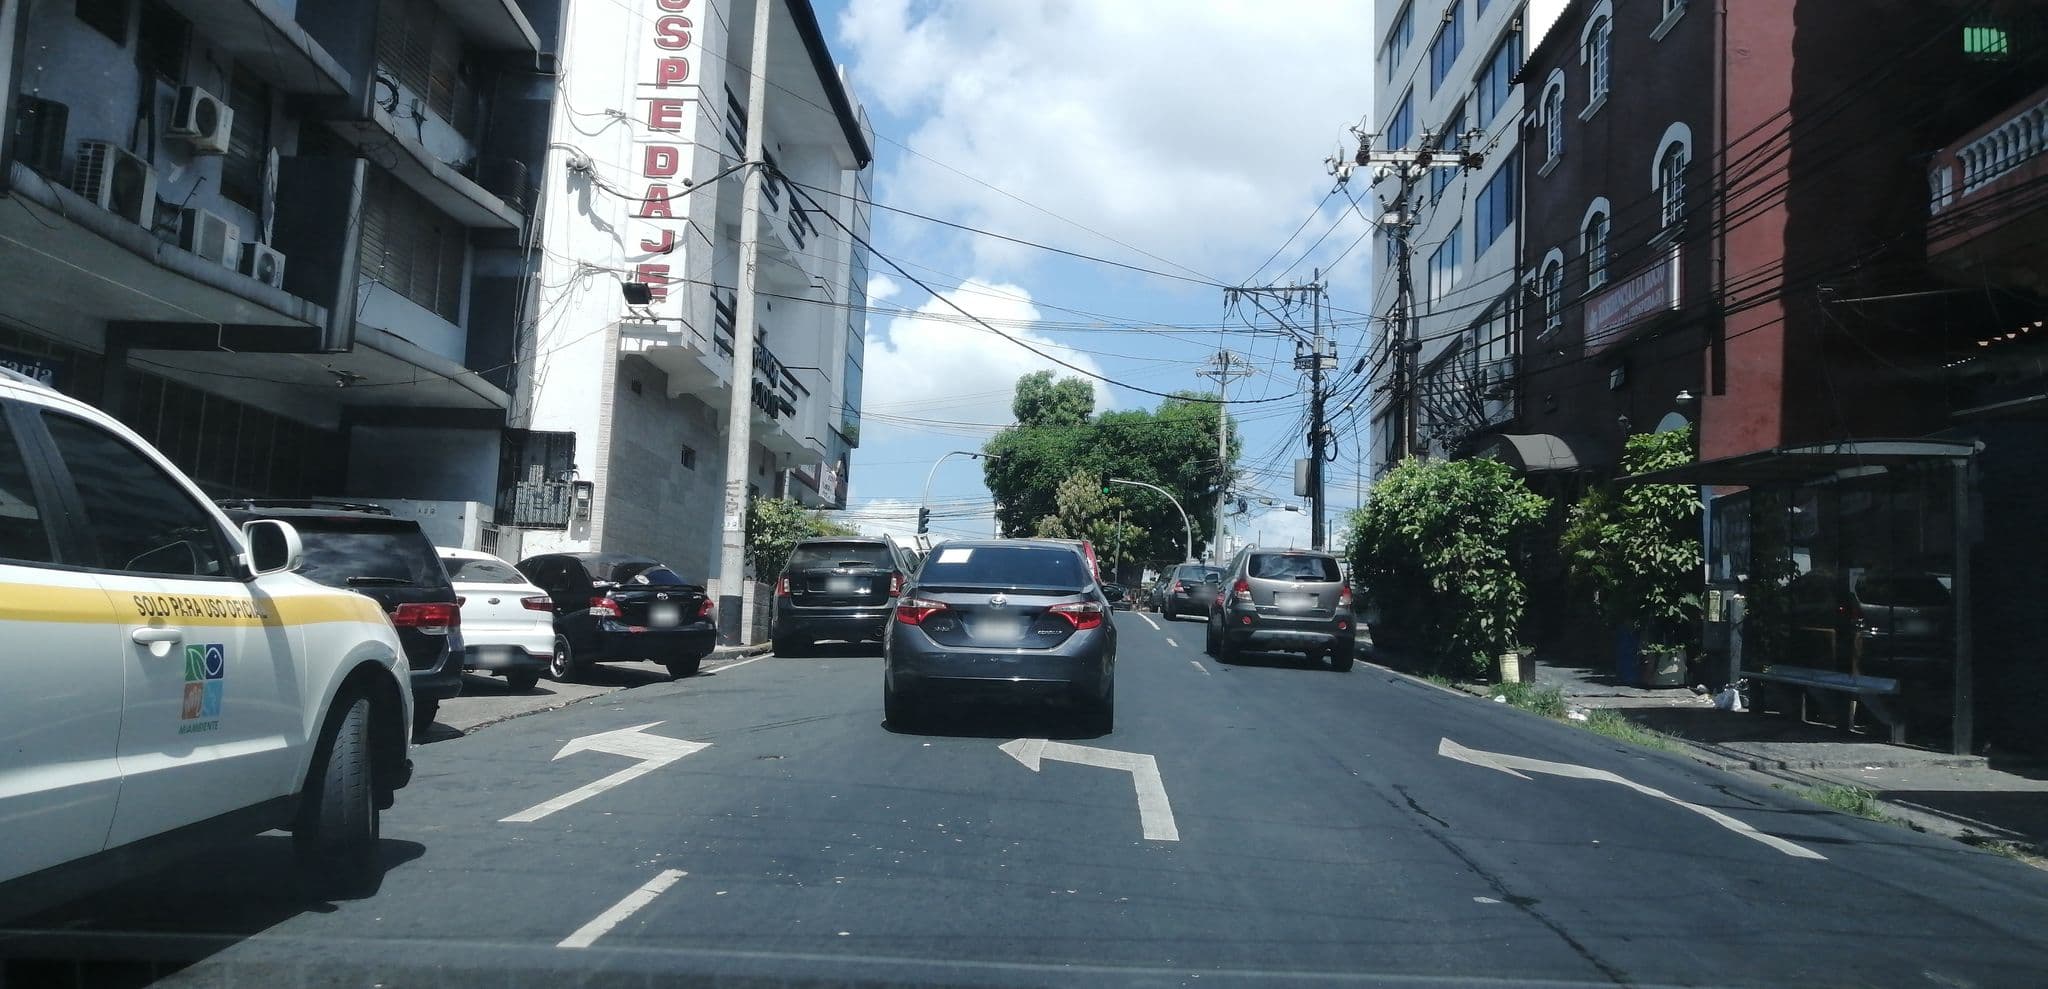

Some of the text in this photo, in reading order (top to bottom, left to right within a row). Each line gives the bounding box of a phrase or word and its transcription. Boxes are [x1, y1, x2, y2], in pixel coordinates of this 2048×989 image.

[133, 594, 268, 619] SOLO PARA USO OFICIAL
